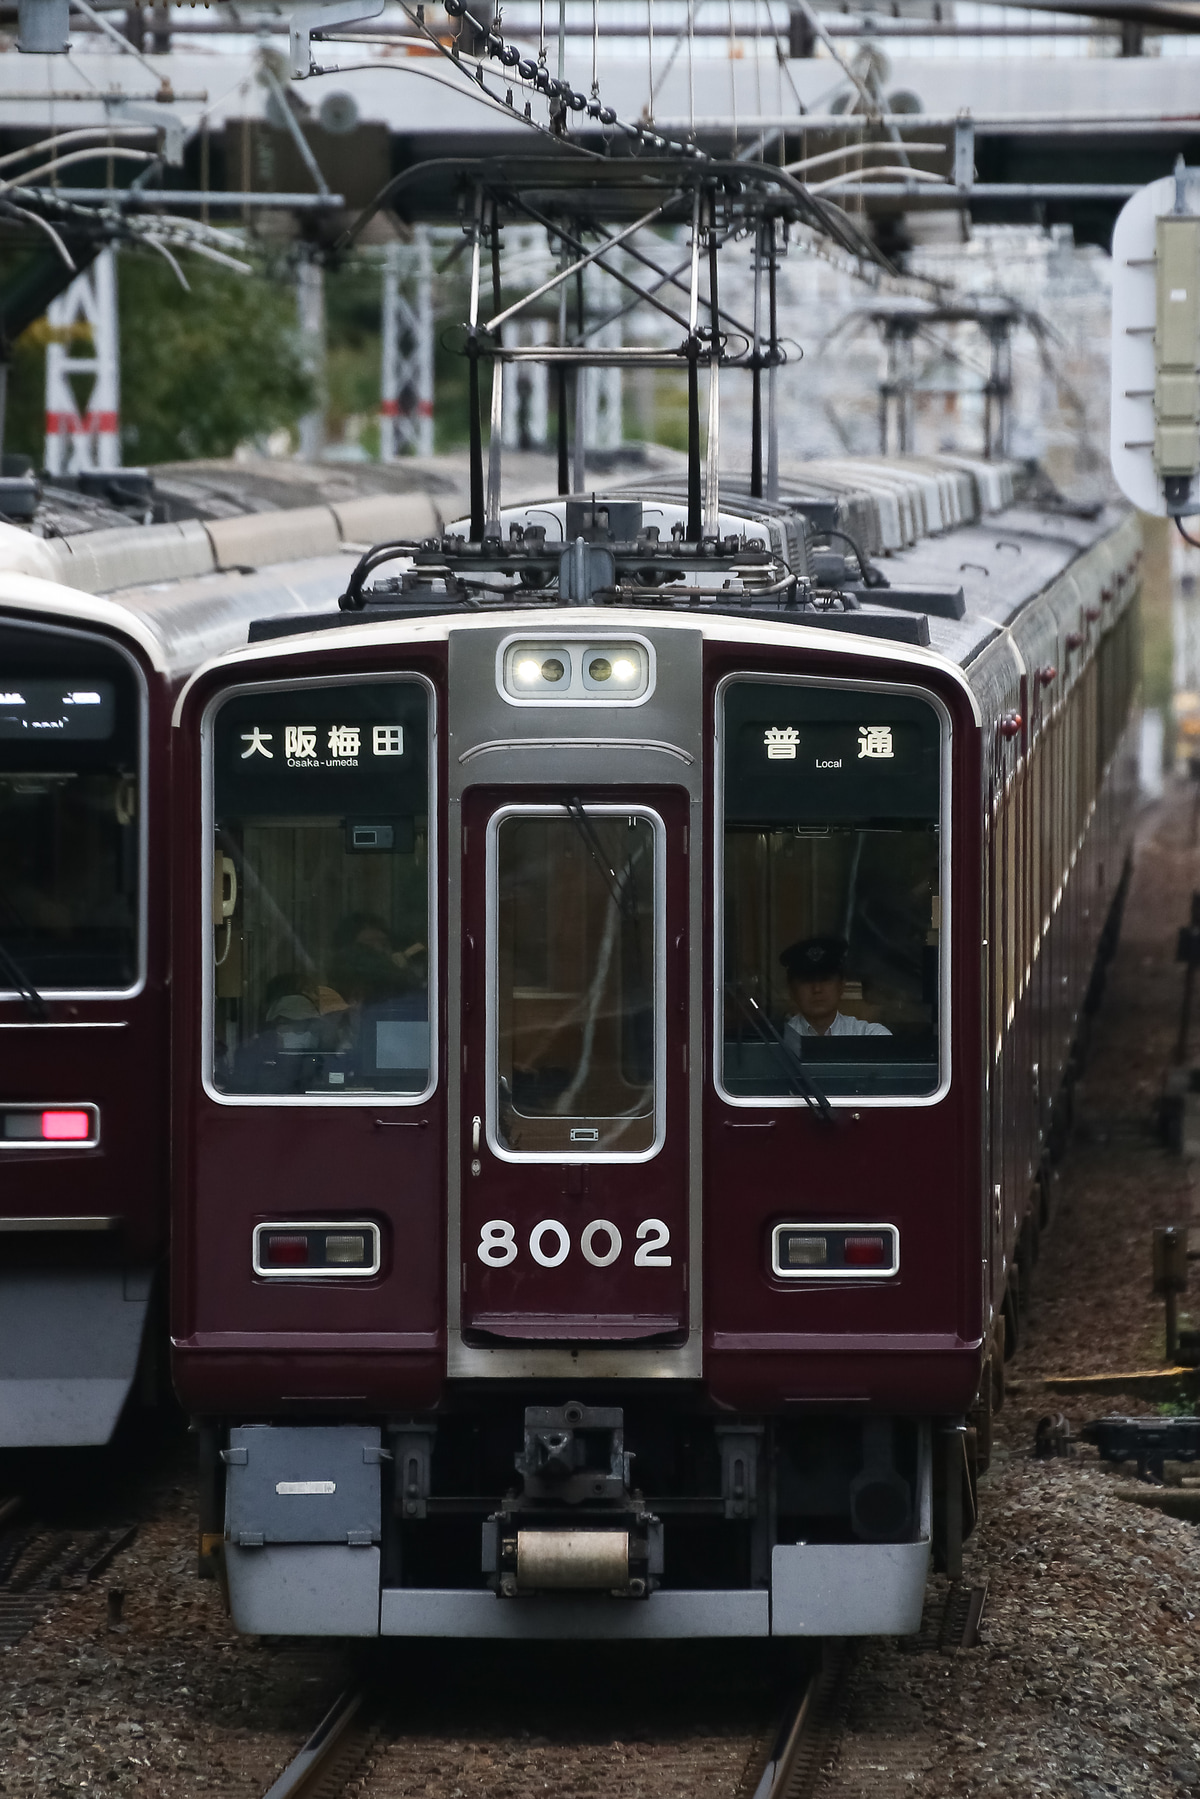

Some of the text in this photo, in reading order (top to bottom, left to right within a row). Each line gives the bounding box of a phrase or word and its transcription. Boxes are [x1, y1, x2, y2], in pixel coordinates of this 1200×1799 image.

[240, 725, 404, 759] 大阪梅田
[763, 726, 895, 760] 普通
[286, 758, 359, 768] Osaka-umeda
[815, 758, 842, 769] Local
[477, 1218, 672, 1268] 8002
